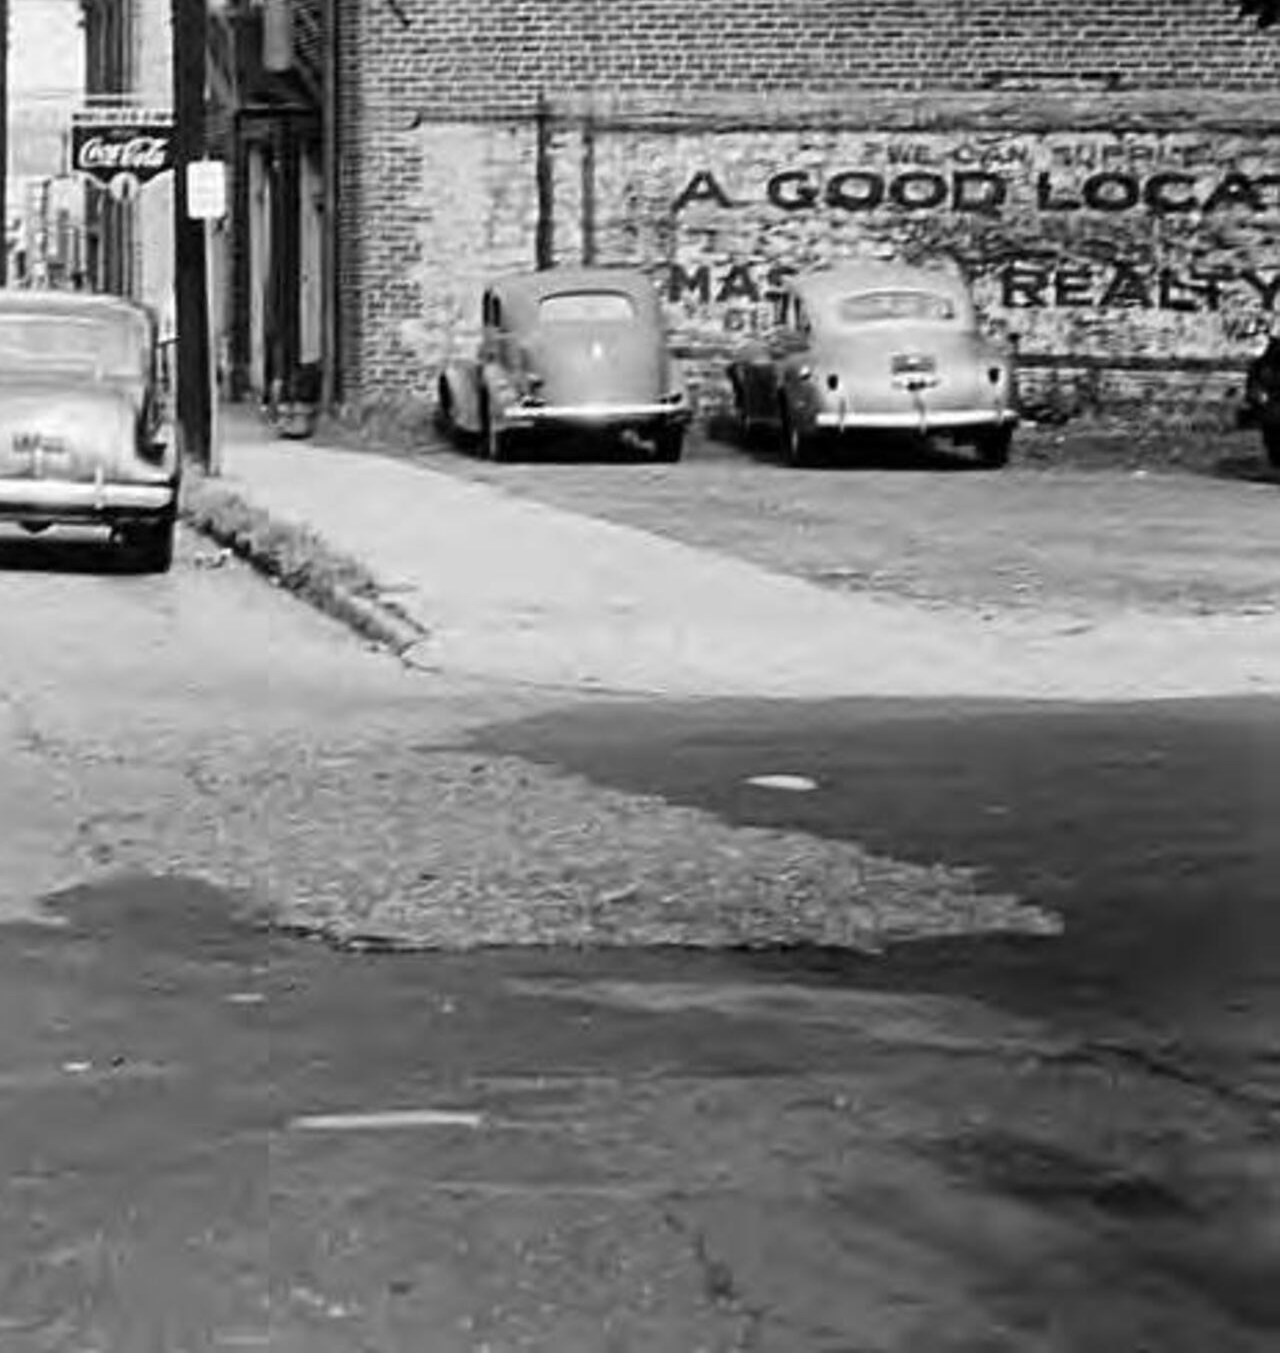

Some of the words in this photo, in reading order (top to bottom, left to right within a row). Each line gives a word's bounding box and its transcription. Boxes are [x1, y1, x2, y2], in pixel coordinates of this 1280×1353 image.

[78, 135, 169, 169] Coca-Cola
[670, 171, 734, 213] A
[766, 171, 1006, 214] GOOD
[1002, 260, 1280, 310] REALTY
